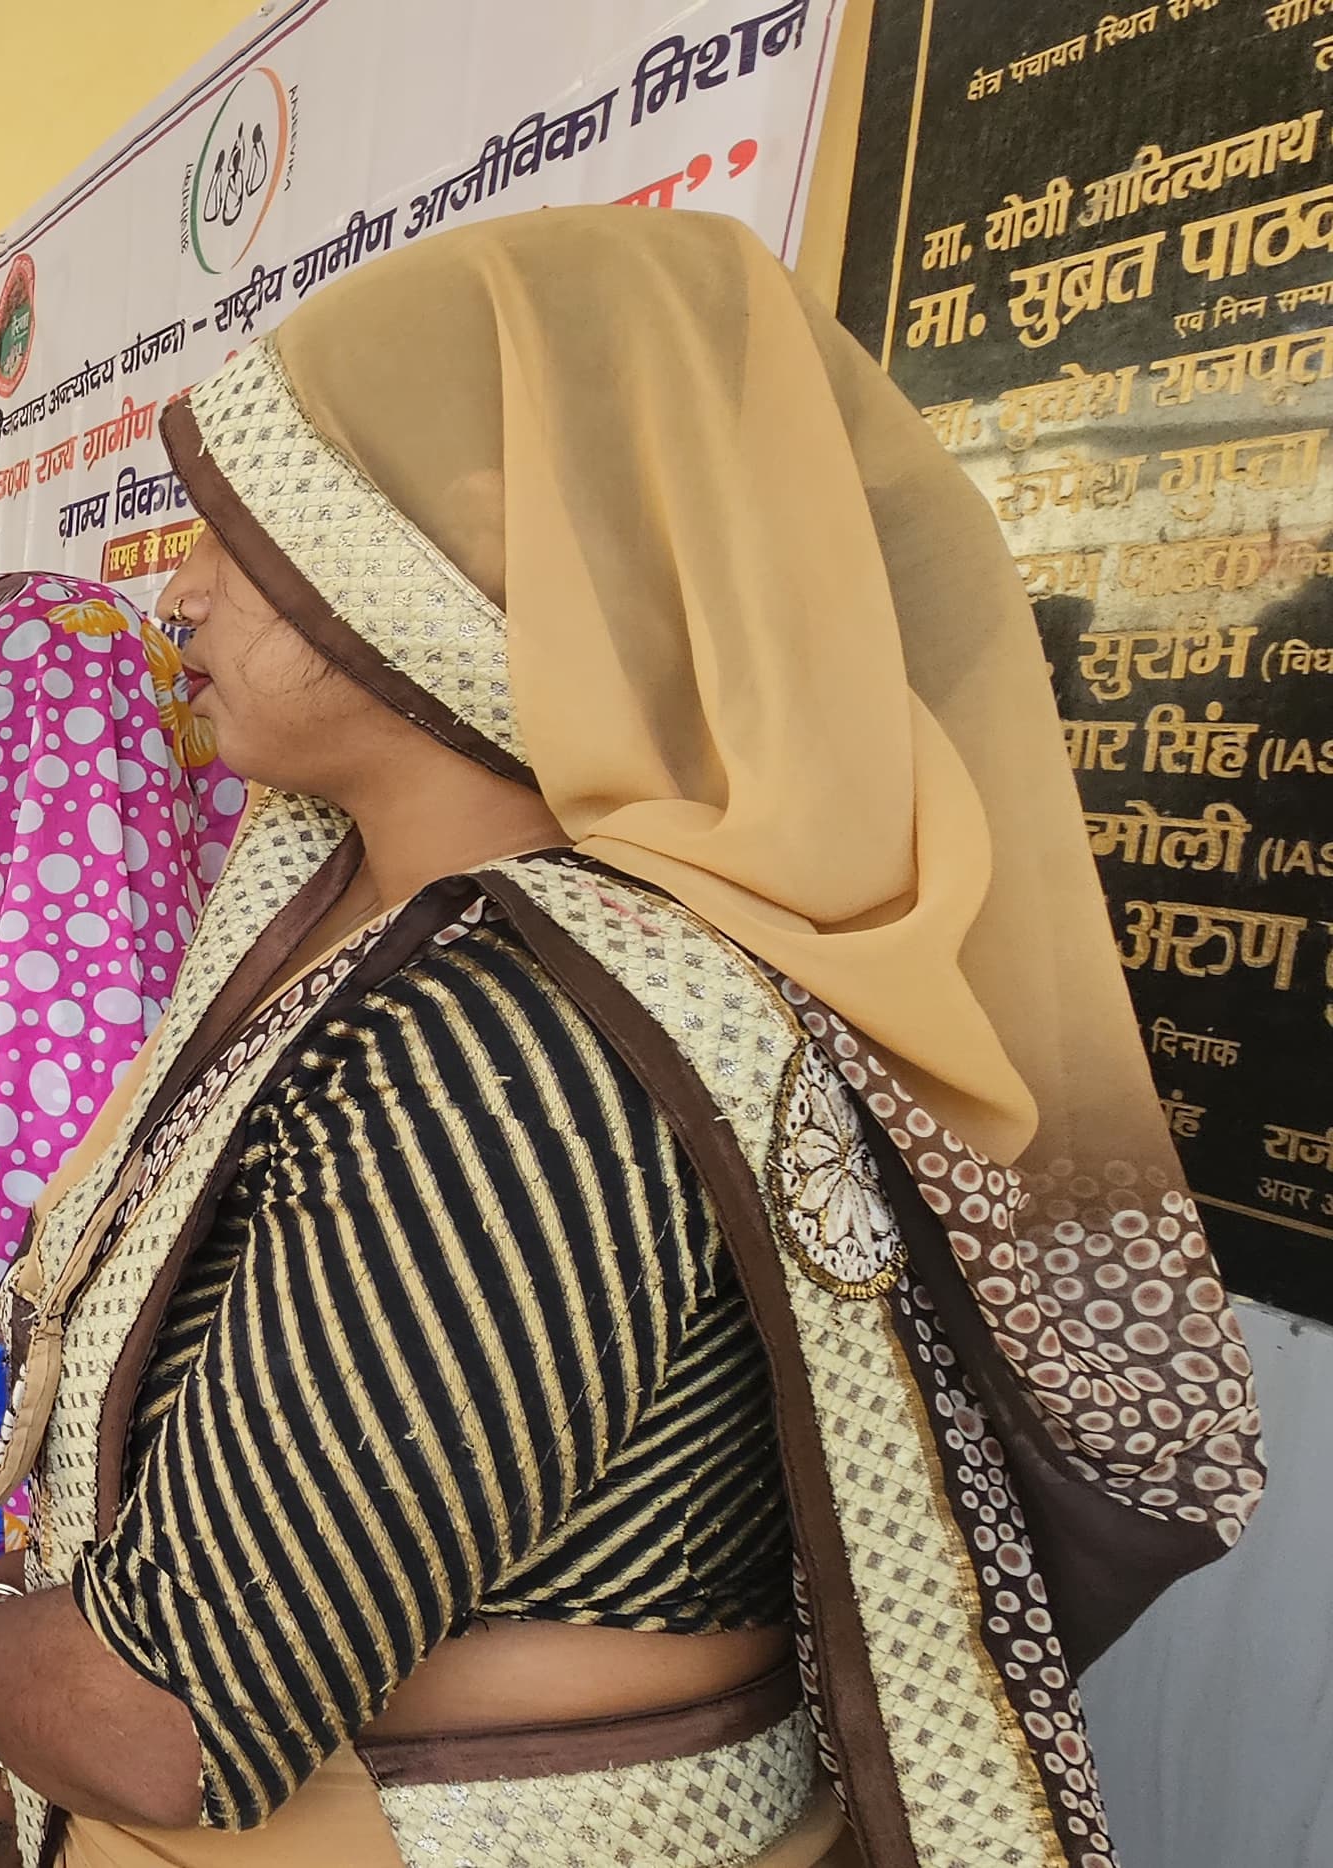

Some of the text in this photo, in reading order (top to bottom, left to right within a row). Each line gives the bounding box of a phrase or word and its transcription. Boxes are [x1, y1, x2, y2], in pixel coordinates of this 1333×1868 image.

[966, 66, 1004, 101] क्षेत्र
[1009, 34, 1088, 84] पंचायत
[1094, 5, 1159, 53] स्थित
[120, 321, 186, 375] योजना
[214, 264, 288, 335] राष्ट्रीय
[292, 210, 398, 299] ग्रामीण
[404, 86, 620, 241] आजीविका
[630, 0, 810, 128] मिशन
[921, 109, 1325, 271] मा. योगी आदित्यनाथ
[906, 283, 987, 349] मा.
[1008, 230, 1167, 349] सुब्रत
[1173, 301, 1207, 341] एवं
[1213, 293, 1269, 329] निम्न
[35, 436, 78, 485] राज्य
[82, 395, 158, 473] ग्रामीण
[998, 362, 1141, 453] मुकेश
[58, 490, 111, 548] ग्राम्य
[1158, 428, 1330, 522] गुप्ता
[1077, 613, 1259, 702] सुरभि
[1142, 702, 1261, 779] सिंह
[1083, 799, 1253, 873] मोली
[1149, 1016, 1242, 1068] दिनांक
[1257, 1176, 1315, 1210] अवर
